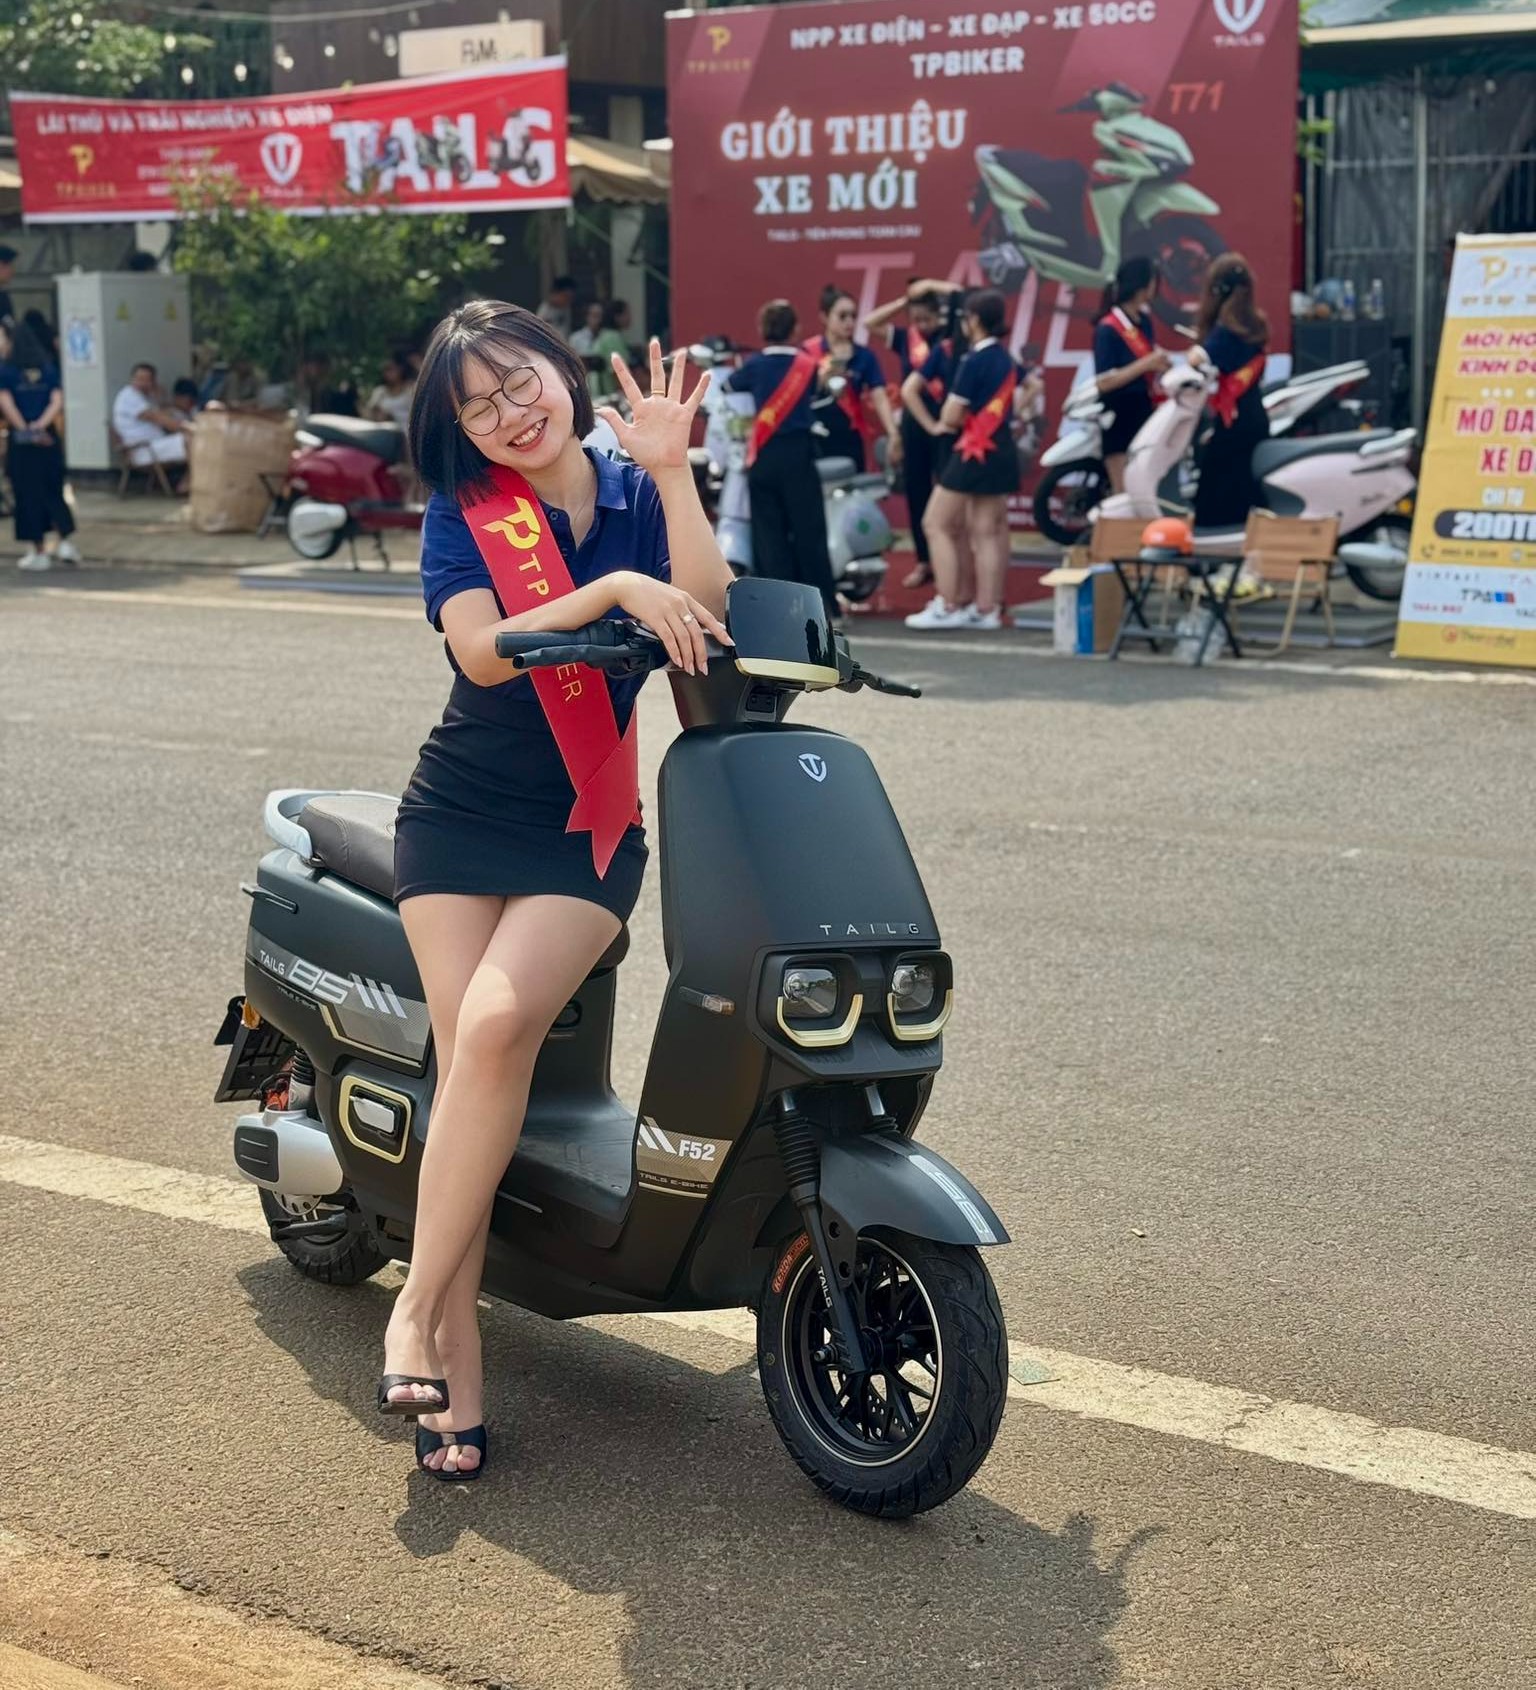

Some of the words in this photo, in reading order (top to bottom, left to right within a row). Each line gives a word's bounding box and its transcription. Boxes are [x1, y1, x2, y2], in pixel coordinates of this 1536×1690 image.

[790, 26, 835, 49] NPP
[839, 23, 867, 46] XE
[948, 14, 977, 37] XE
[1053, 5, 1083, 29] XE
[1088, 0, 1156, 26] 50CC
[909, 46, 1025, 79] TPBIKER
[1169, 80, 1224, 114] T71
[720, 106, 813, 160] GIỚI
[825, 98, 967, 164] THIỆU
[330, 107, 556, 193] TAILG
[753, 174, 813, 215] XE
[827, 157, 918, 212] MỚI
[1459, 359, 1509, 373] KINH
[1481, 448, 1508, 472] XE
[517, 552, 584, 703] TPER
[820, 923, 920, 936] TAILG
[259, 949, 286, 976] TAILG
[678, 1139, 716, 1162] F52
[670, 1179, 709, 1190] E-BIKE
[773, 1254, 793, 1292] KENDA
[817, 1266, 833, 1308] TAILG
